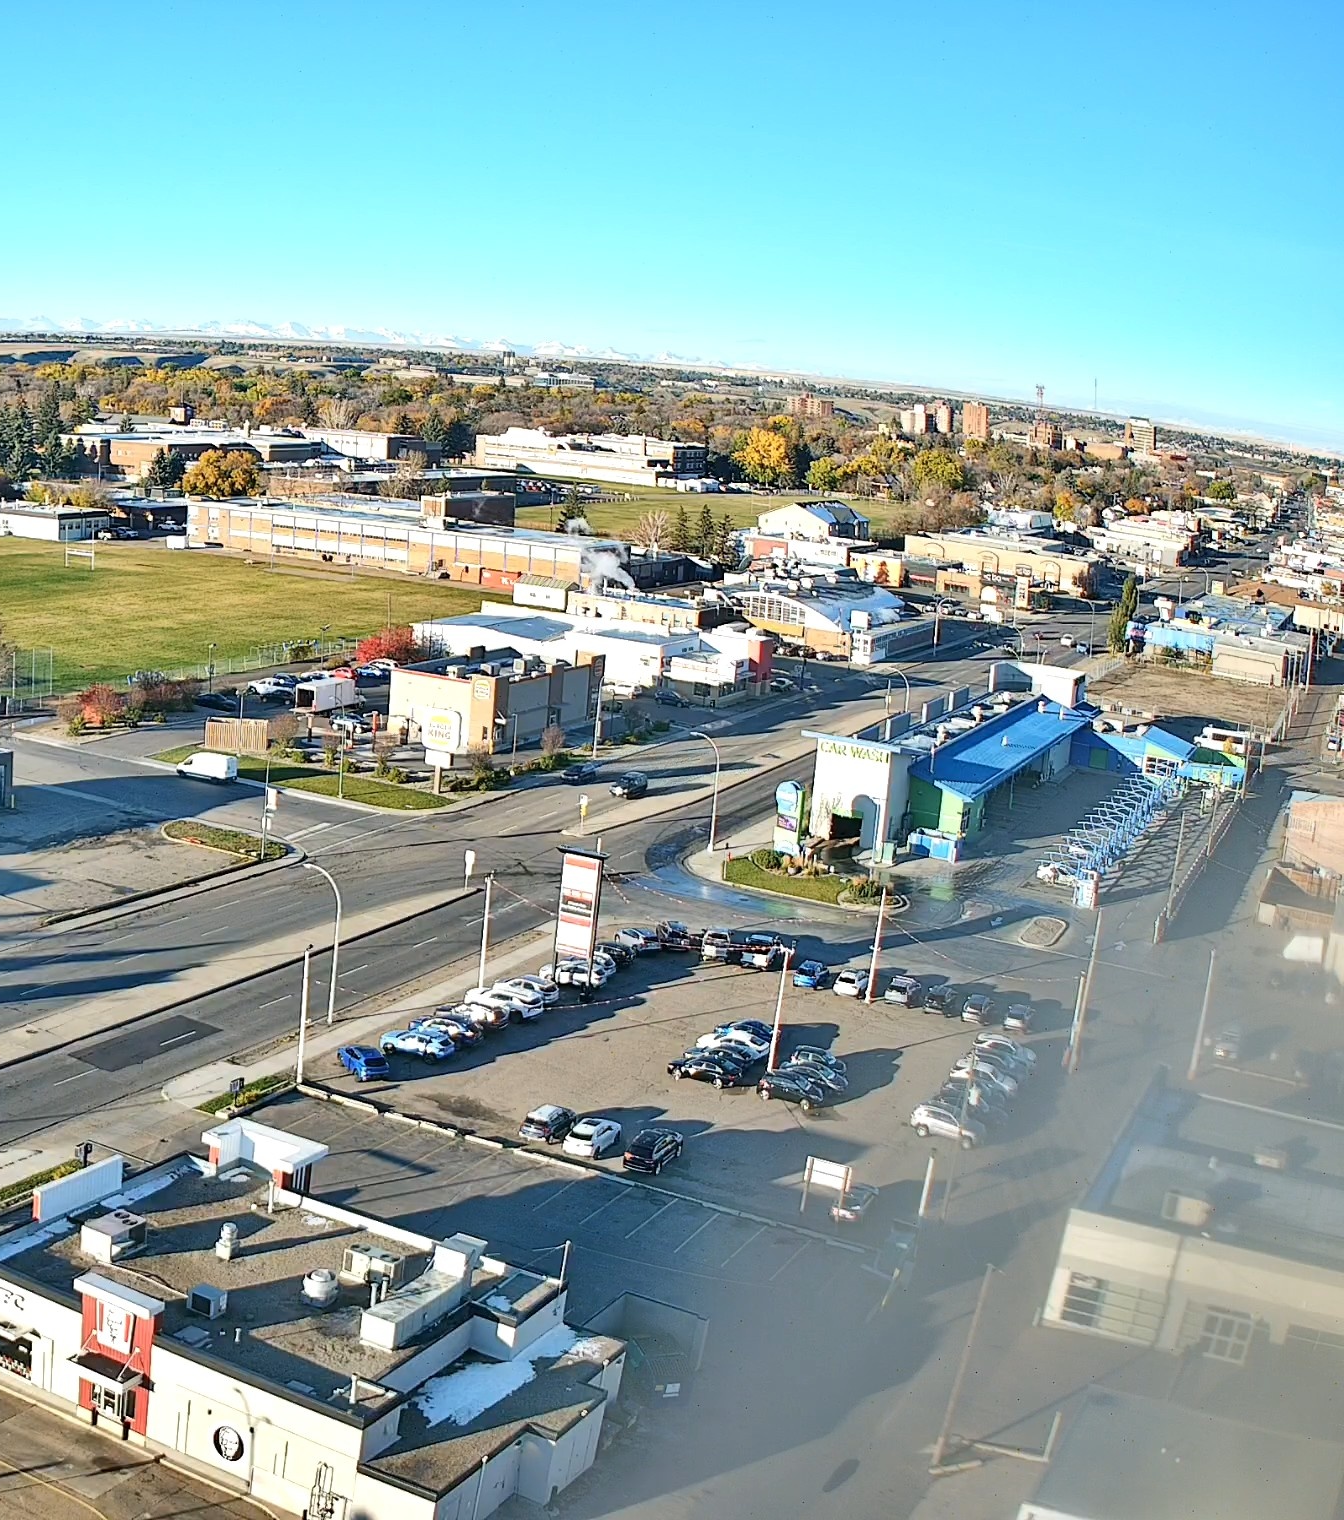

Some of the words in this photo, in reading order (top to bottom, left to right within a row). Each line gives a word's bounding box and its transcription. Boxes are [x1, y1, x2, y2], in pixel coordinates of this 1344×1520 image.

[428, 729, 451, 740] KING
[820, 741, 847, 756] CAR
[850, 747, 889, 763] WASH
